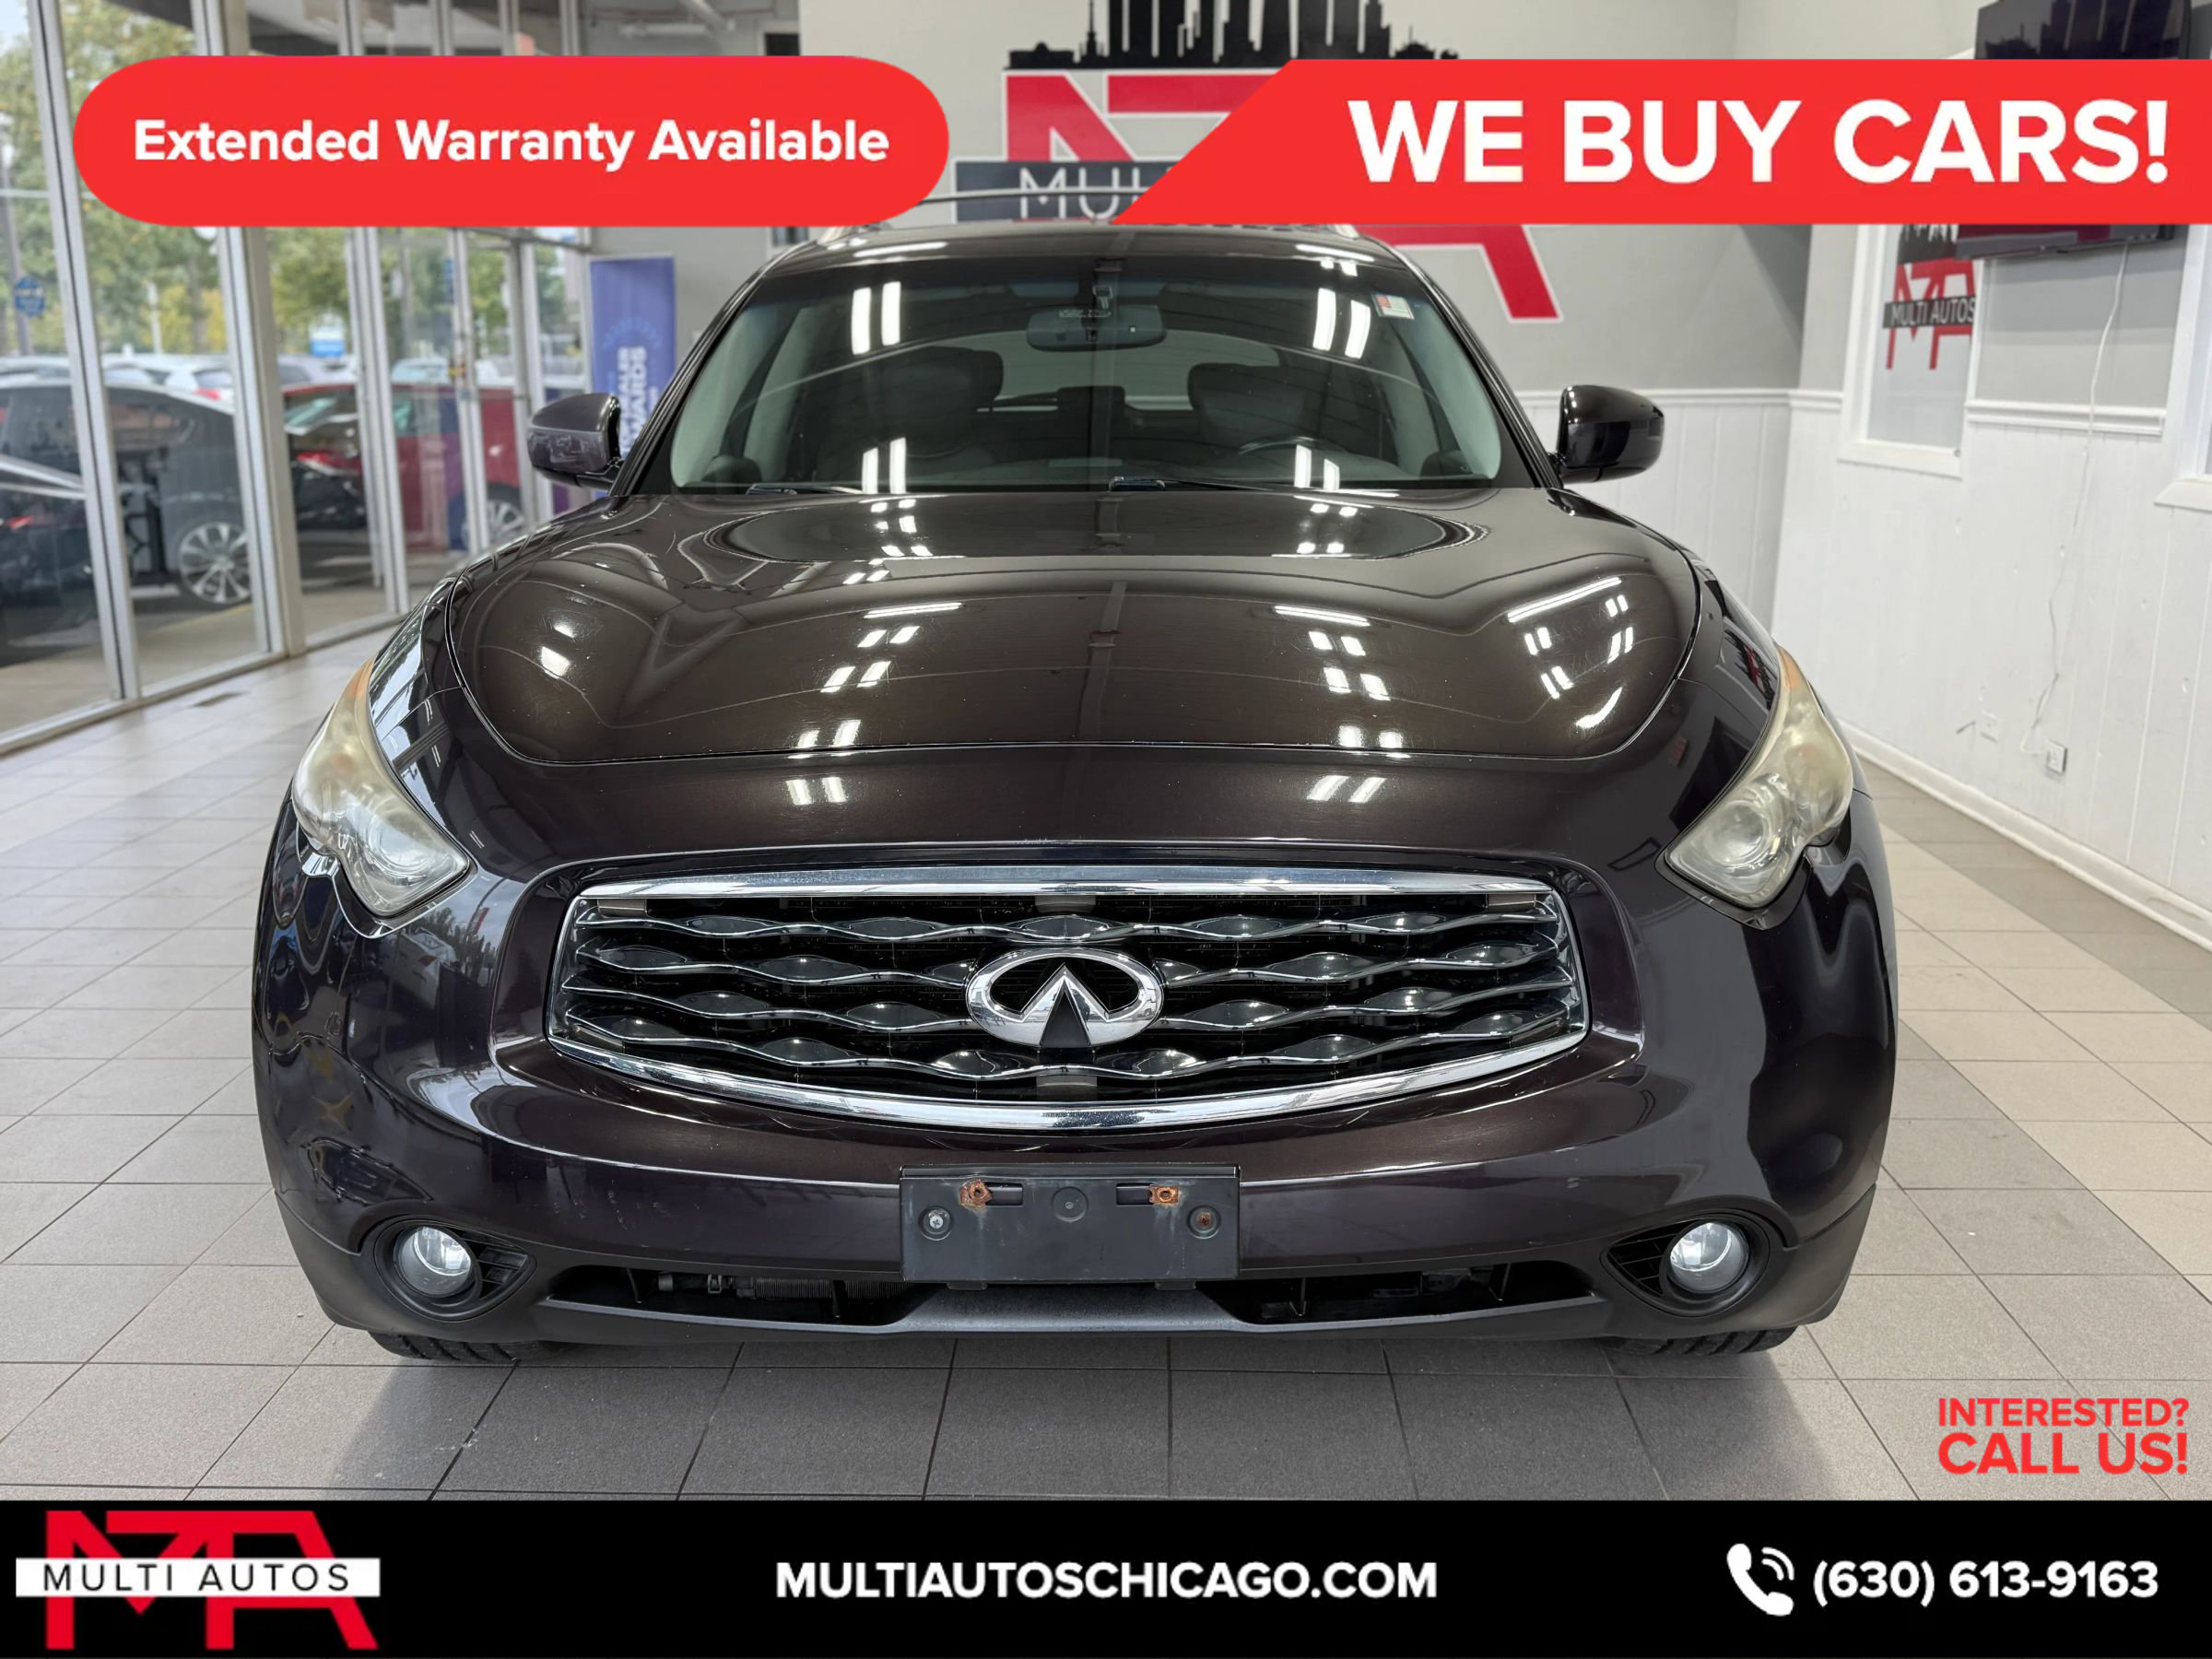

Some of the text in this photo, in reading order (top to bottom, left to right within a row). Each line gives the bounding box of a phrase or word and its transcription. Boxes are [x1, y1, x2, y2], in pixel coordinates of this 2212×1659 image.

[1891, 298, 1976, 325] MULTI AUTOS
[630, 347, 647, 441] WARDS
